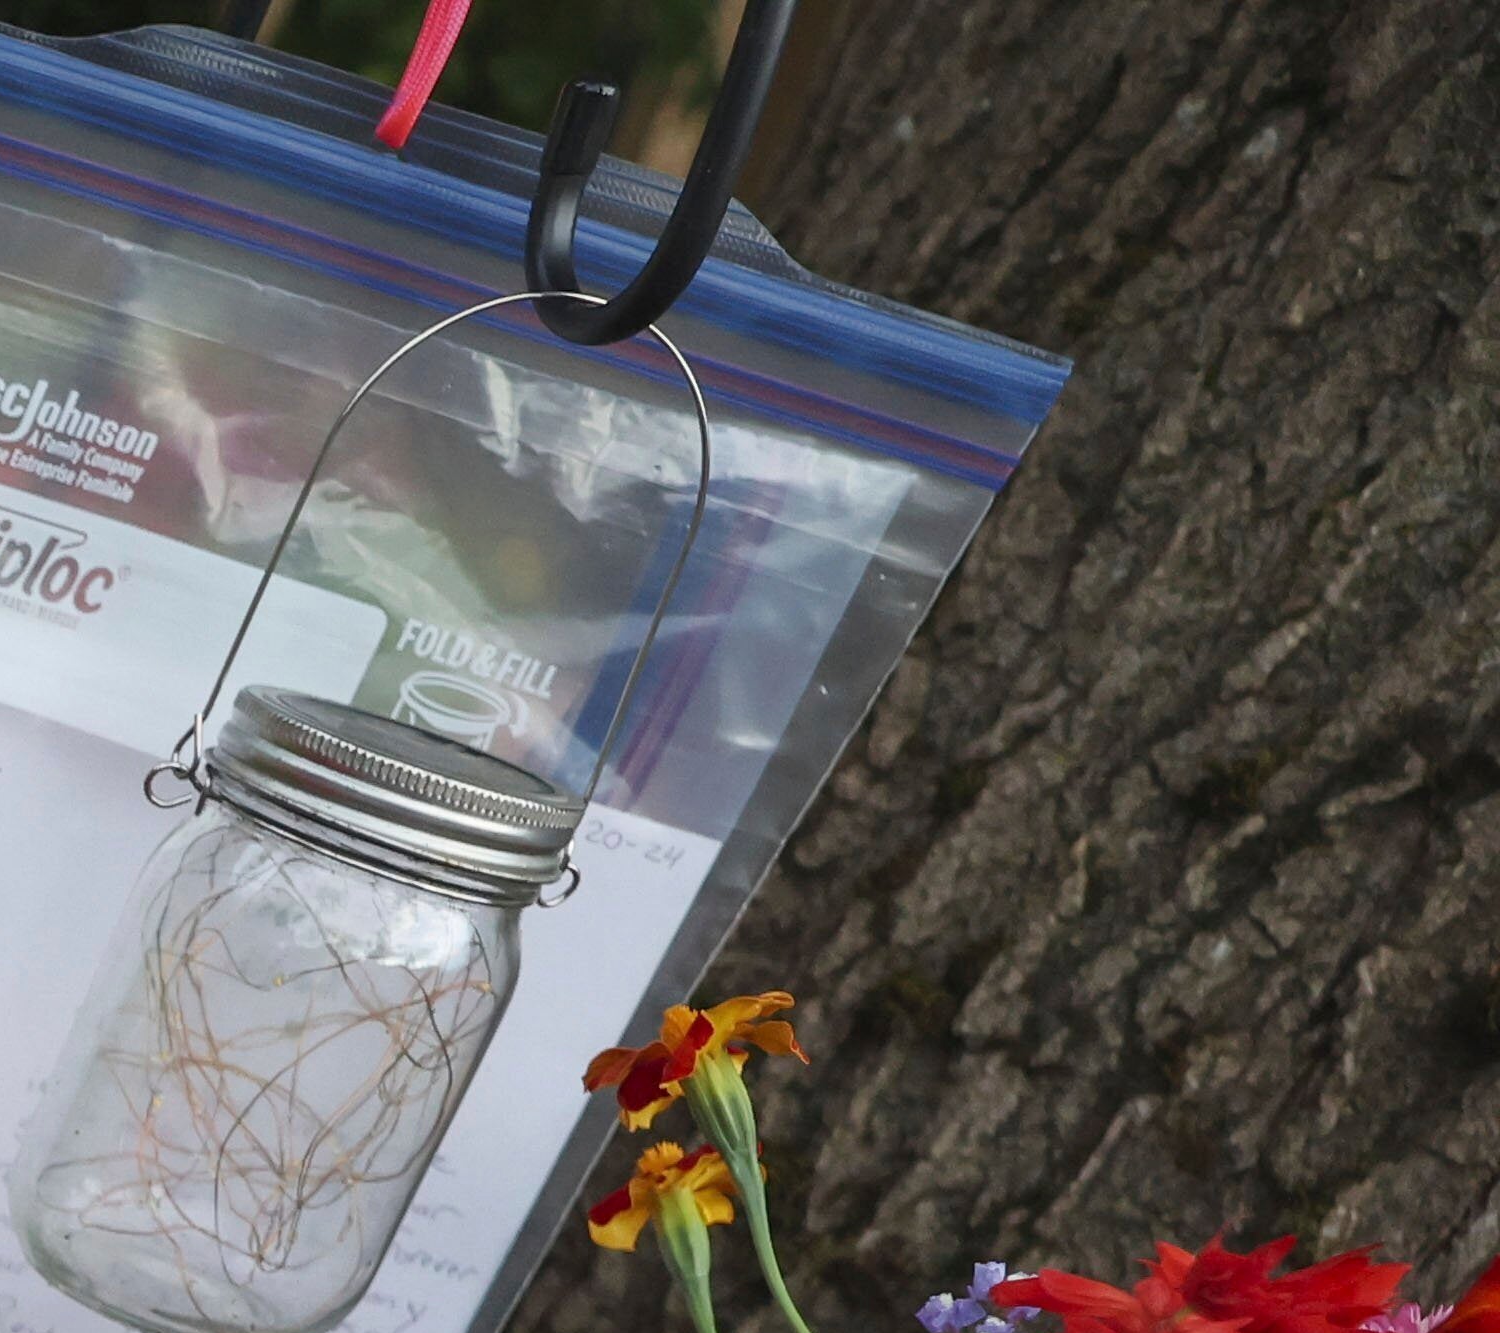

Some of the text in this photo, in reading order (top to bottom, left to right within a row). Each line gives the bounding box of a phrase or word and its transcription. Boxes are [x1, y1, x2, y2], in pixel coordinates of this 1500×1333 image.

[26, 429, 146, 484] A Family Company
